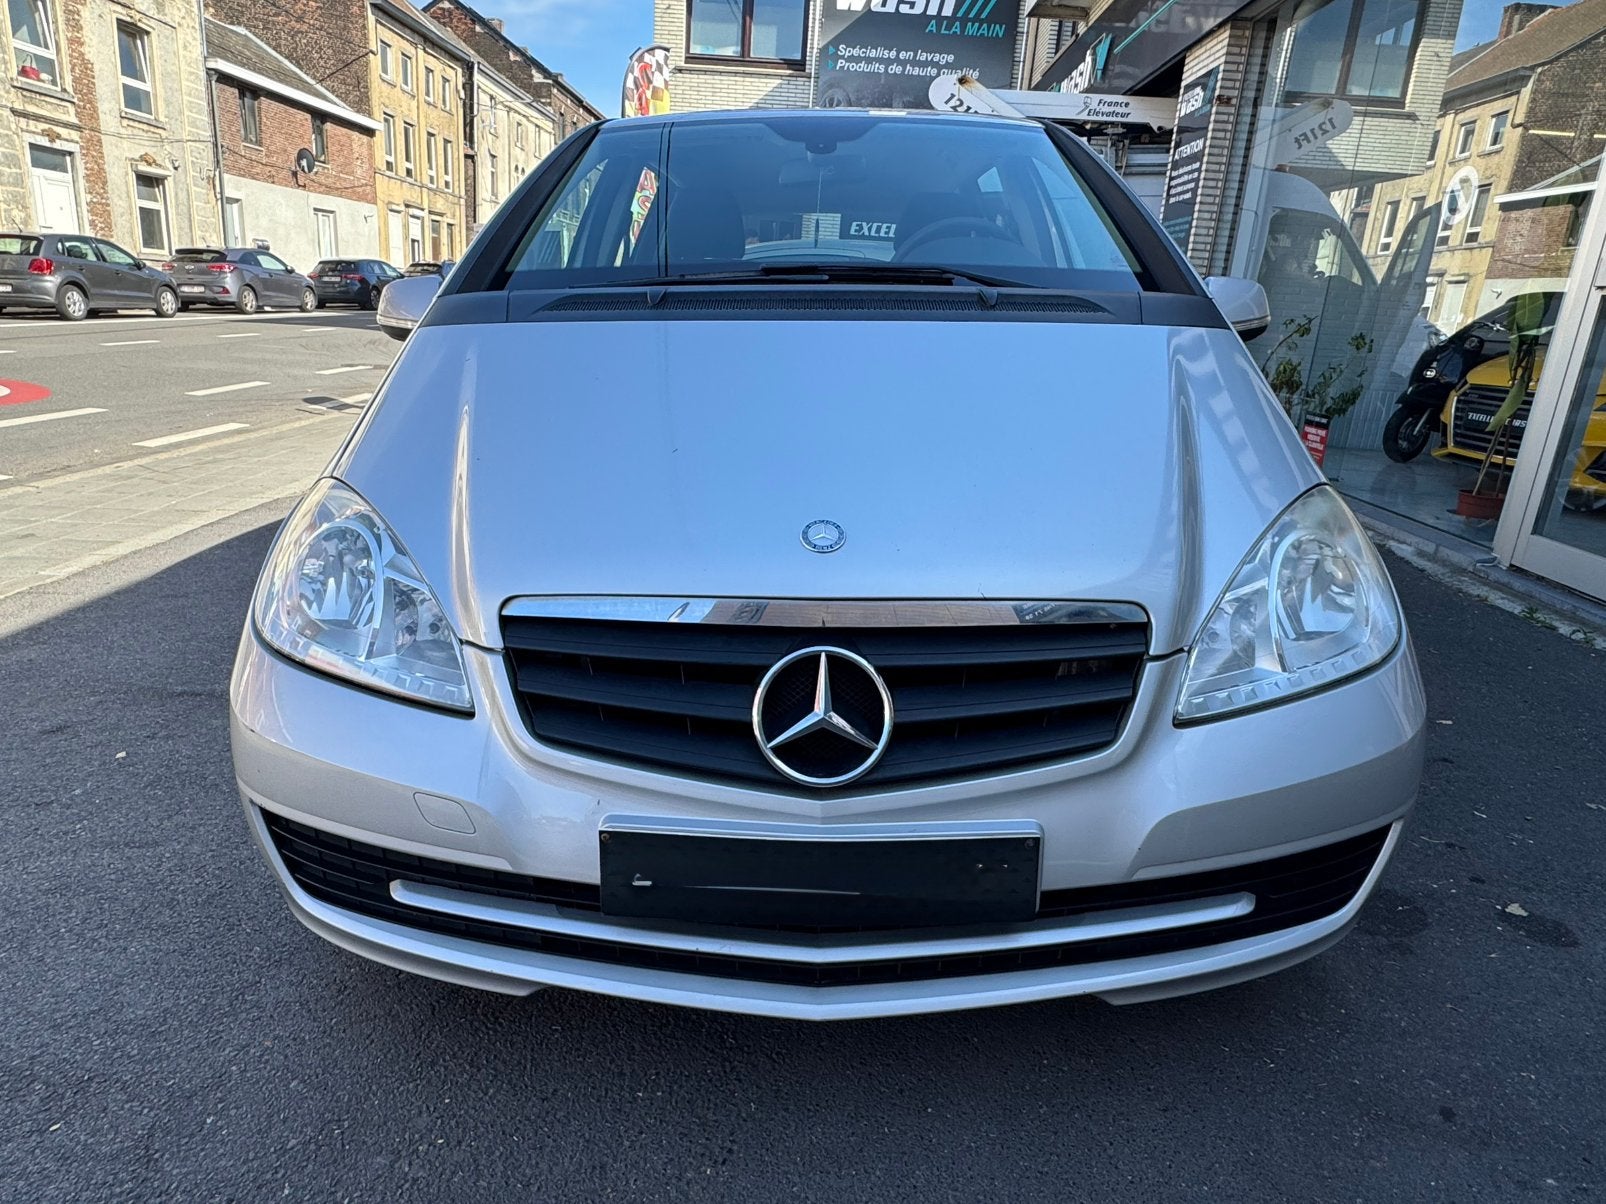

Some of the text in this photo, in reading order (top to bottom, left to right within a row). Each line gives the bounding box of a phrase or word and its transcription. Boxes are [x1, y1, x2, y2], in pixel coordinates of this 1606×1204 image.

[925, 19, 1006, 38] A LA MAIN
[837, 44, 955, 65] Spécialisé en lavage
[836, 59, 980, 79] Produits de haute qualité
[944, 92, 979, 114] 121
[1097, 98, 1131, 108] France
[1086, 108, 1131, 119] Elévateur
[849, 221, 897, 238] EXCEL
